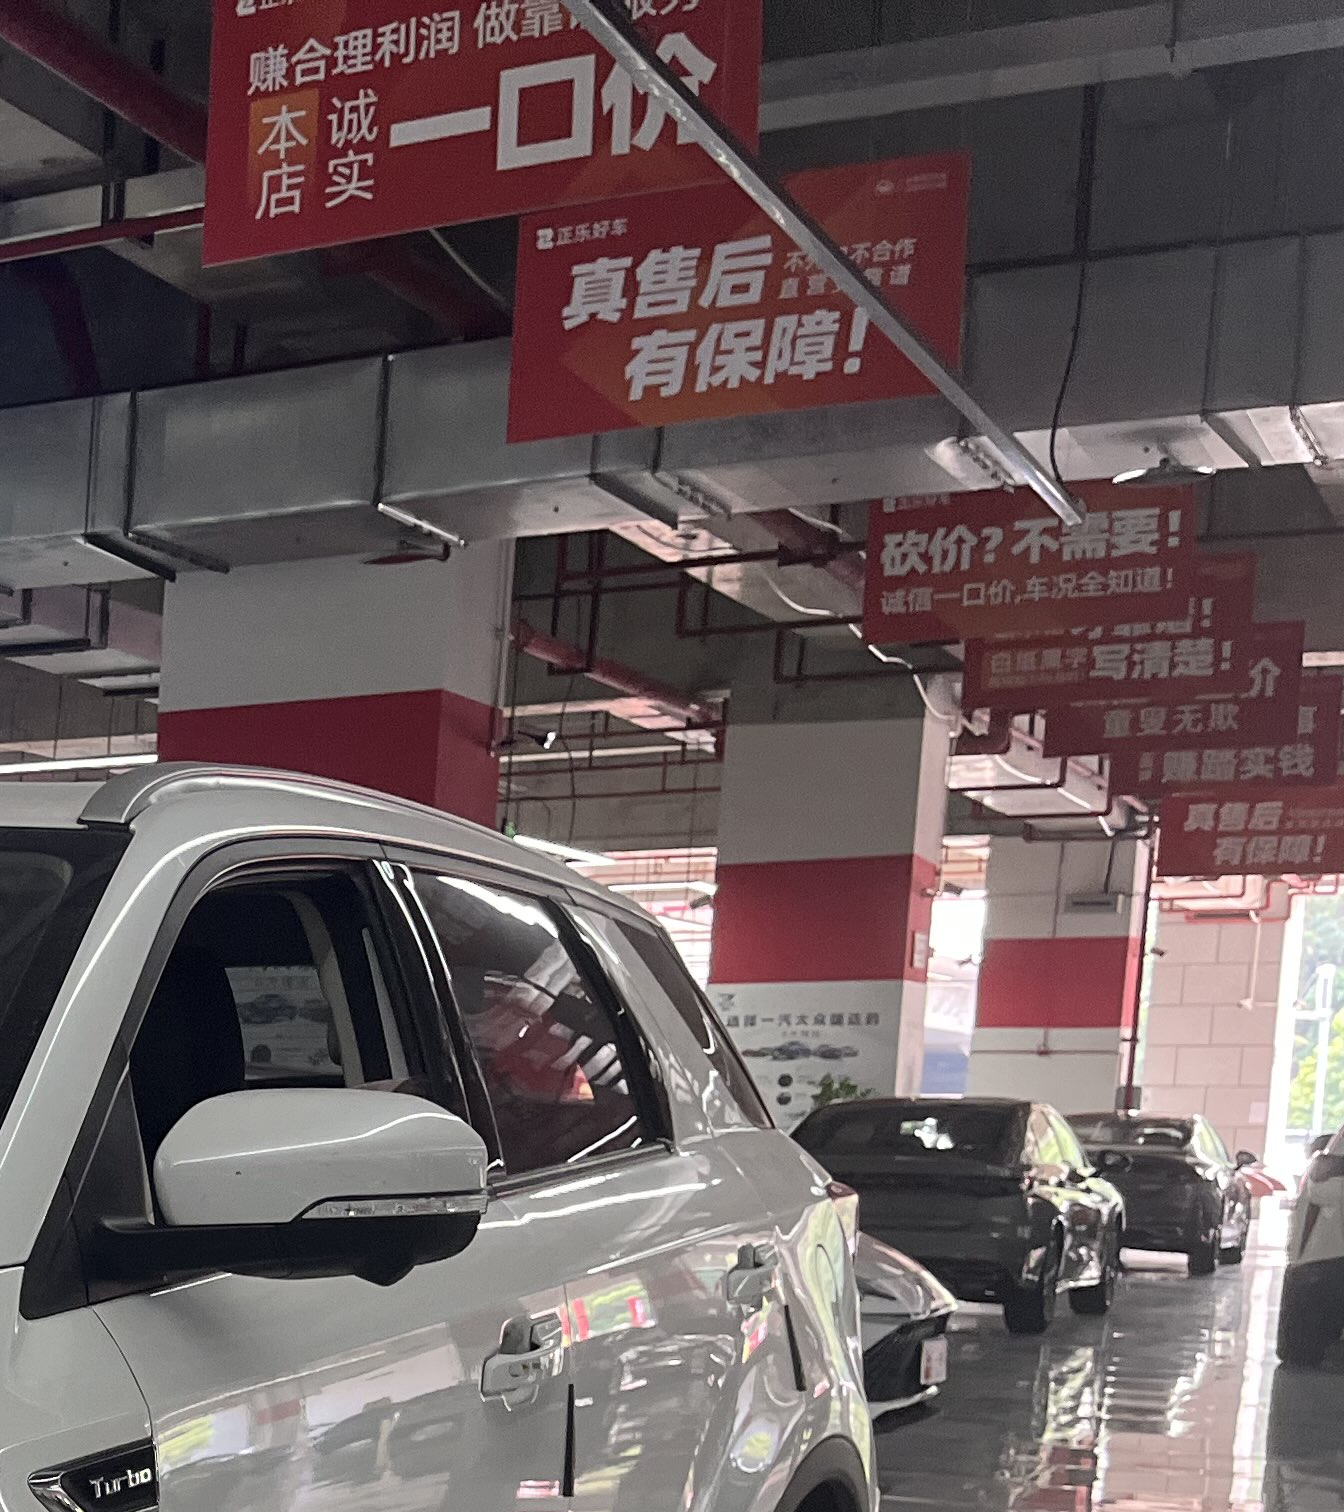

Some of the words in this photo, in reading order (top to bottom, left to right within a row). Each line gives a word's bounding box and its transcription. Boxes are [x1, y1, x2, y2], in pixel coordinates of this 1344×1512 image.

[247, 9, 461, 96] 赚合理利润
[388, 31, 718, 172] 一口价
[257, 104, 309, 220] 本店
[324, 88, 379, 209] 诚实
[561, 233, 774, 332] 真售后
[88, 1467, 143, 1499] Turbo
